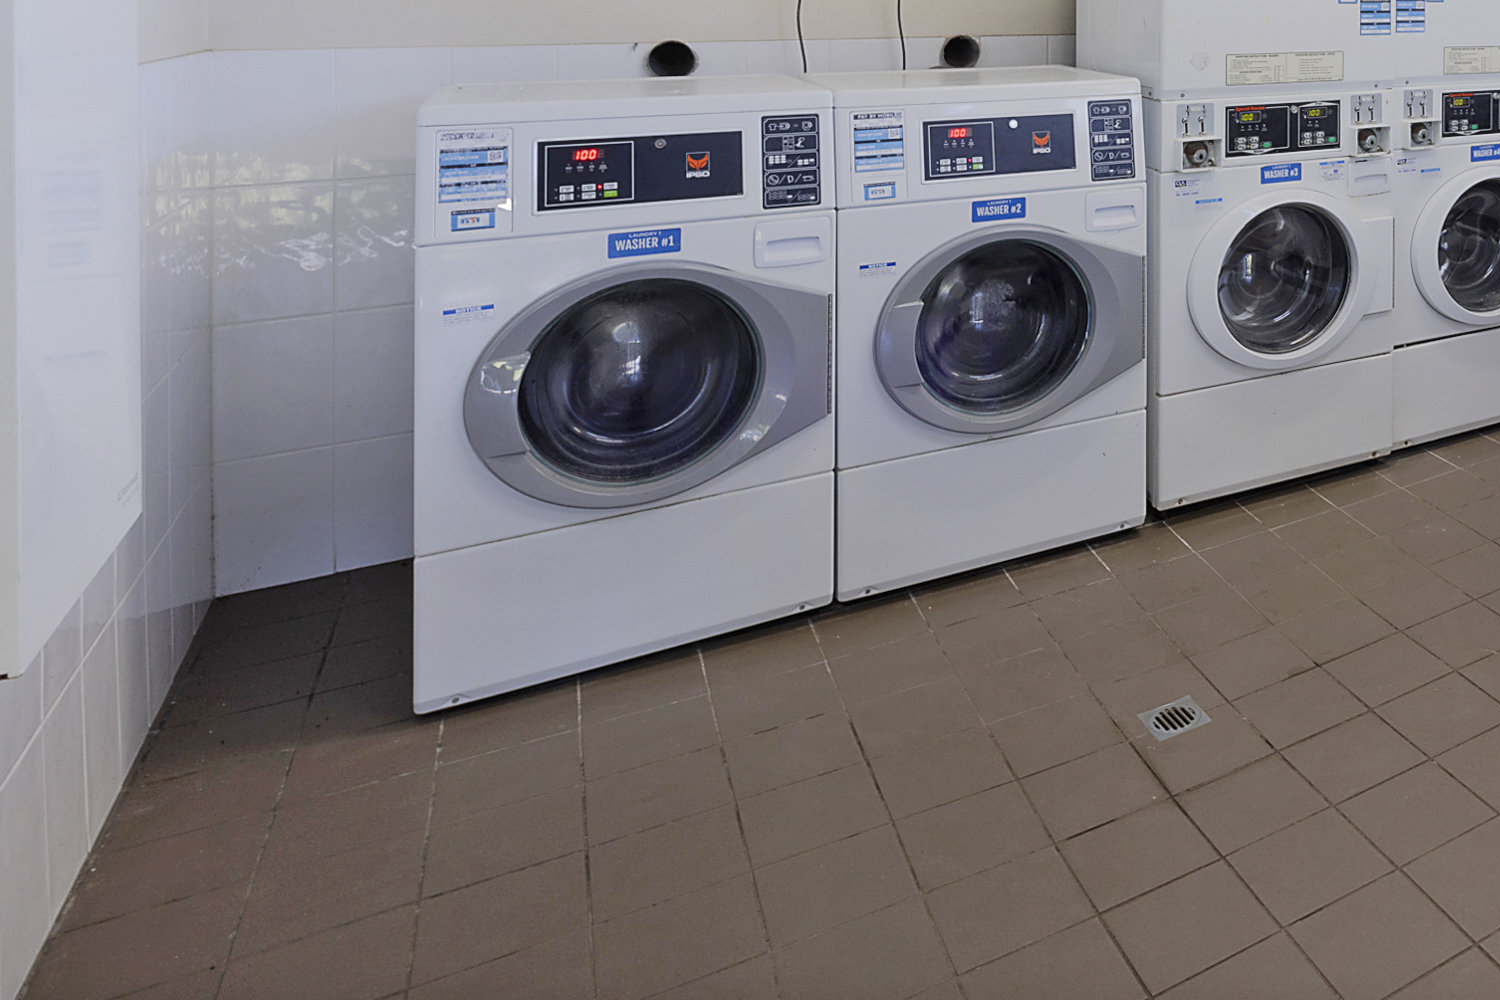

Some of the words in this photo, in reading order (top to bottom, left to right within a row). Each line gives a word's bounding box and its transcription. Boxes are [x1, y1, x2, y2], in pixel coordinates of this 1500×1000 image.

[1240, 113, 1254, 122] 100
[1308, 109, 1321, 117] 100
[949, 127, 967, 138] 100
[574, 148, 598, 161] 100
[1472, 148, 1493, 158] WASHER
[1493, 147, 1500, 156] #4
[685, 170, 710, 179] IPSO
[1263, 169, 1289, 179] WASHER
[1289, 167, 1299, 177] #3
[976, 204, 1009, 217] WASHER
[1010, 203, 1022, 213] #2
[628, 231, 658, 239] LAUNDRY
[615, 237, 659, 252] WASHER
[661, 235, 674, 247] #1
